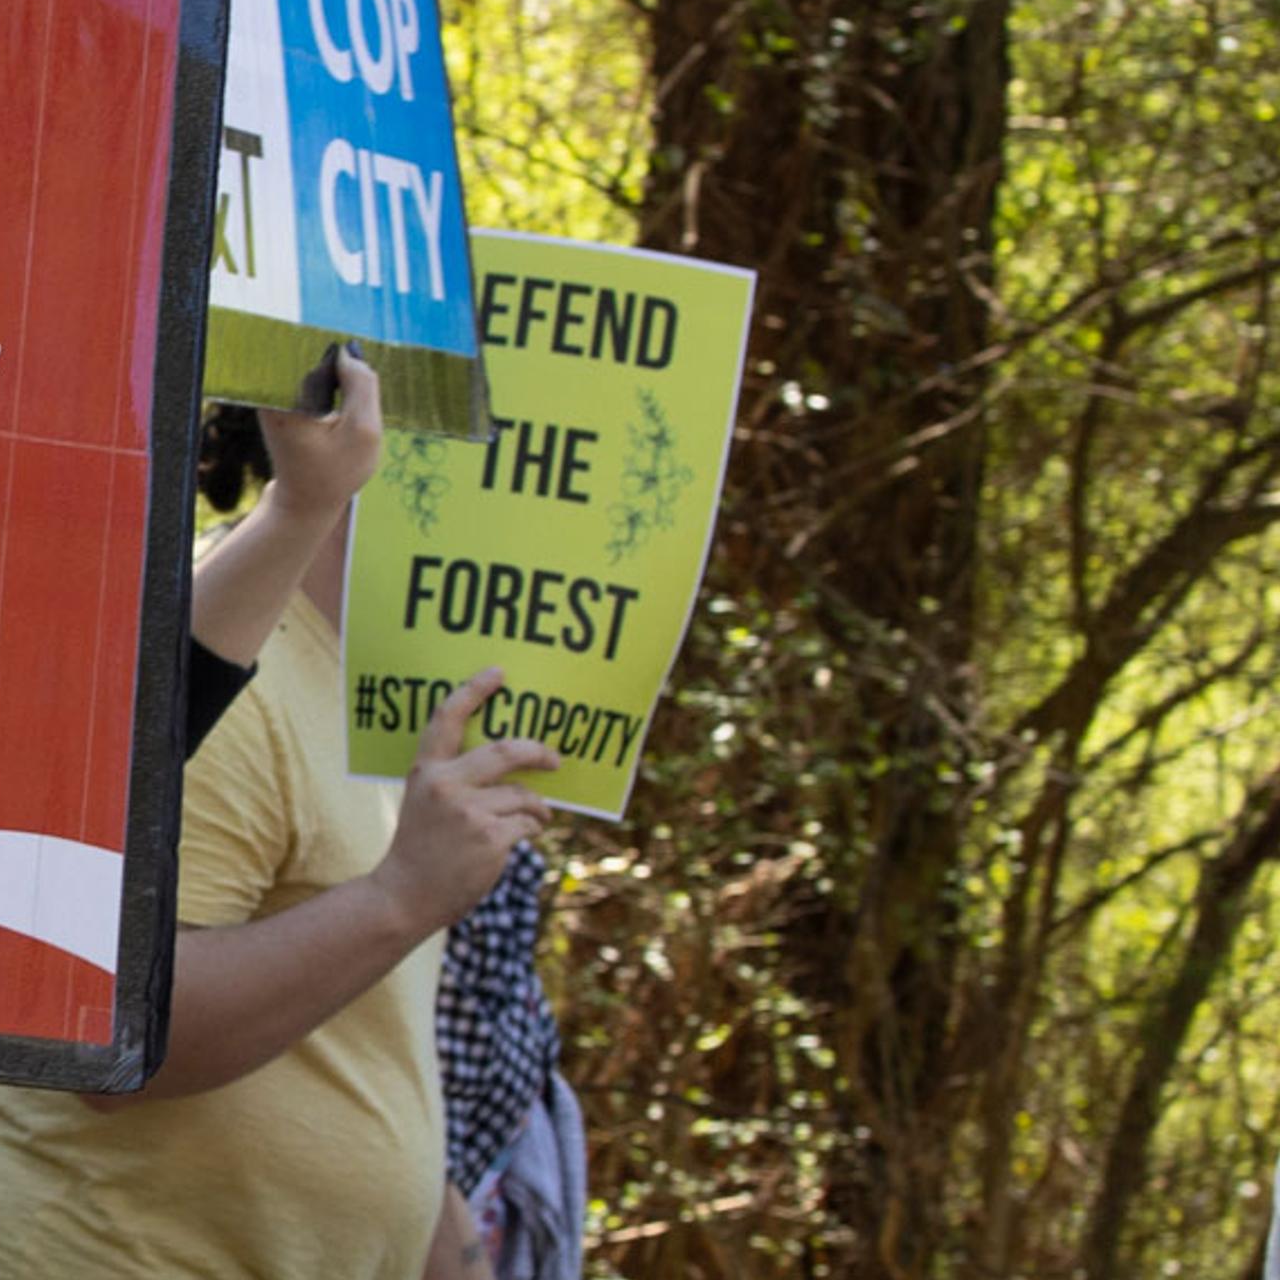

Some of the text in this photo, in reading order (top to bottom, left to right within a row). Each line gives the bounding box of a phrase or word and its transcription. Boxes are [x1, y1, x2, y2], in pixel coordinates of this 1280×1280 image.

[319, 139, 444, 300] CITY
[480, 273, 680, 371] EFEND
[480, 416, 599, 504] THE
[403, 555, 639, 662] FOREST
[355, 673, 643, 768] #STOCOPCITY
